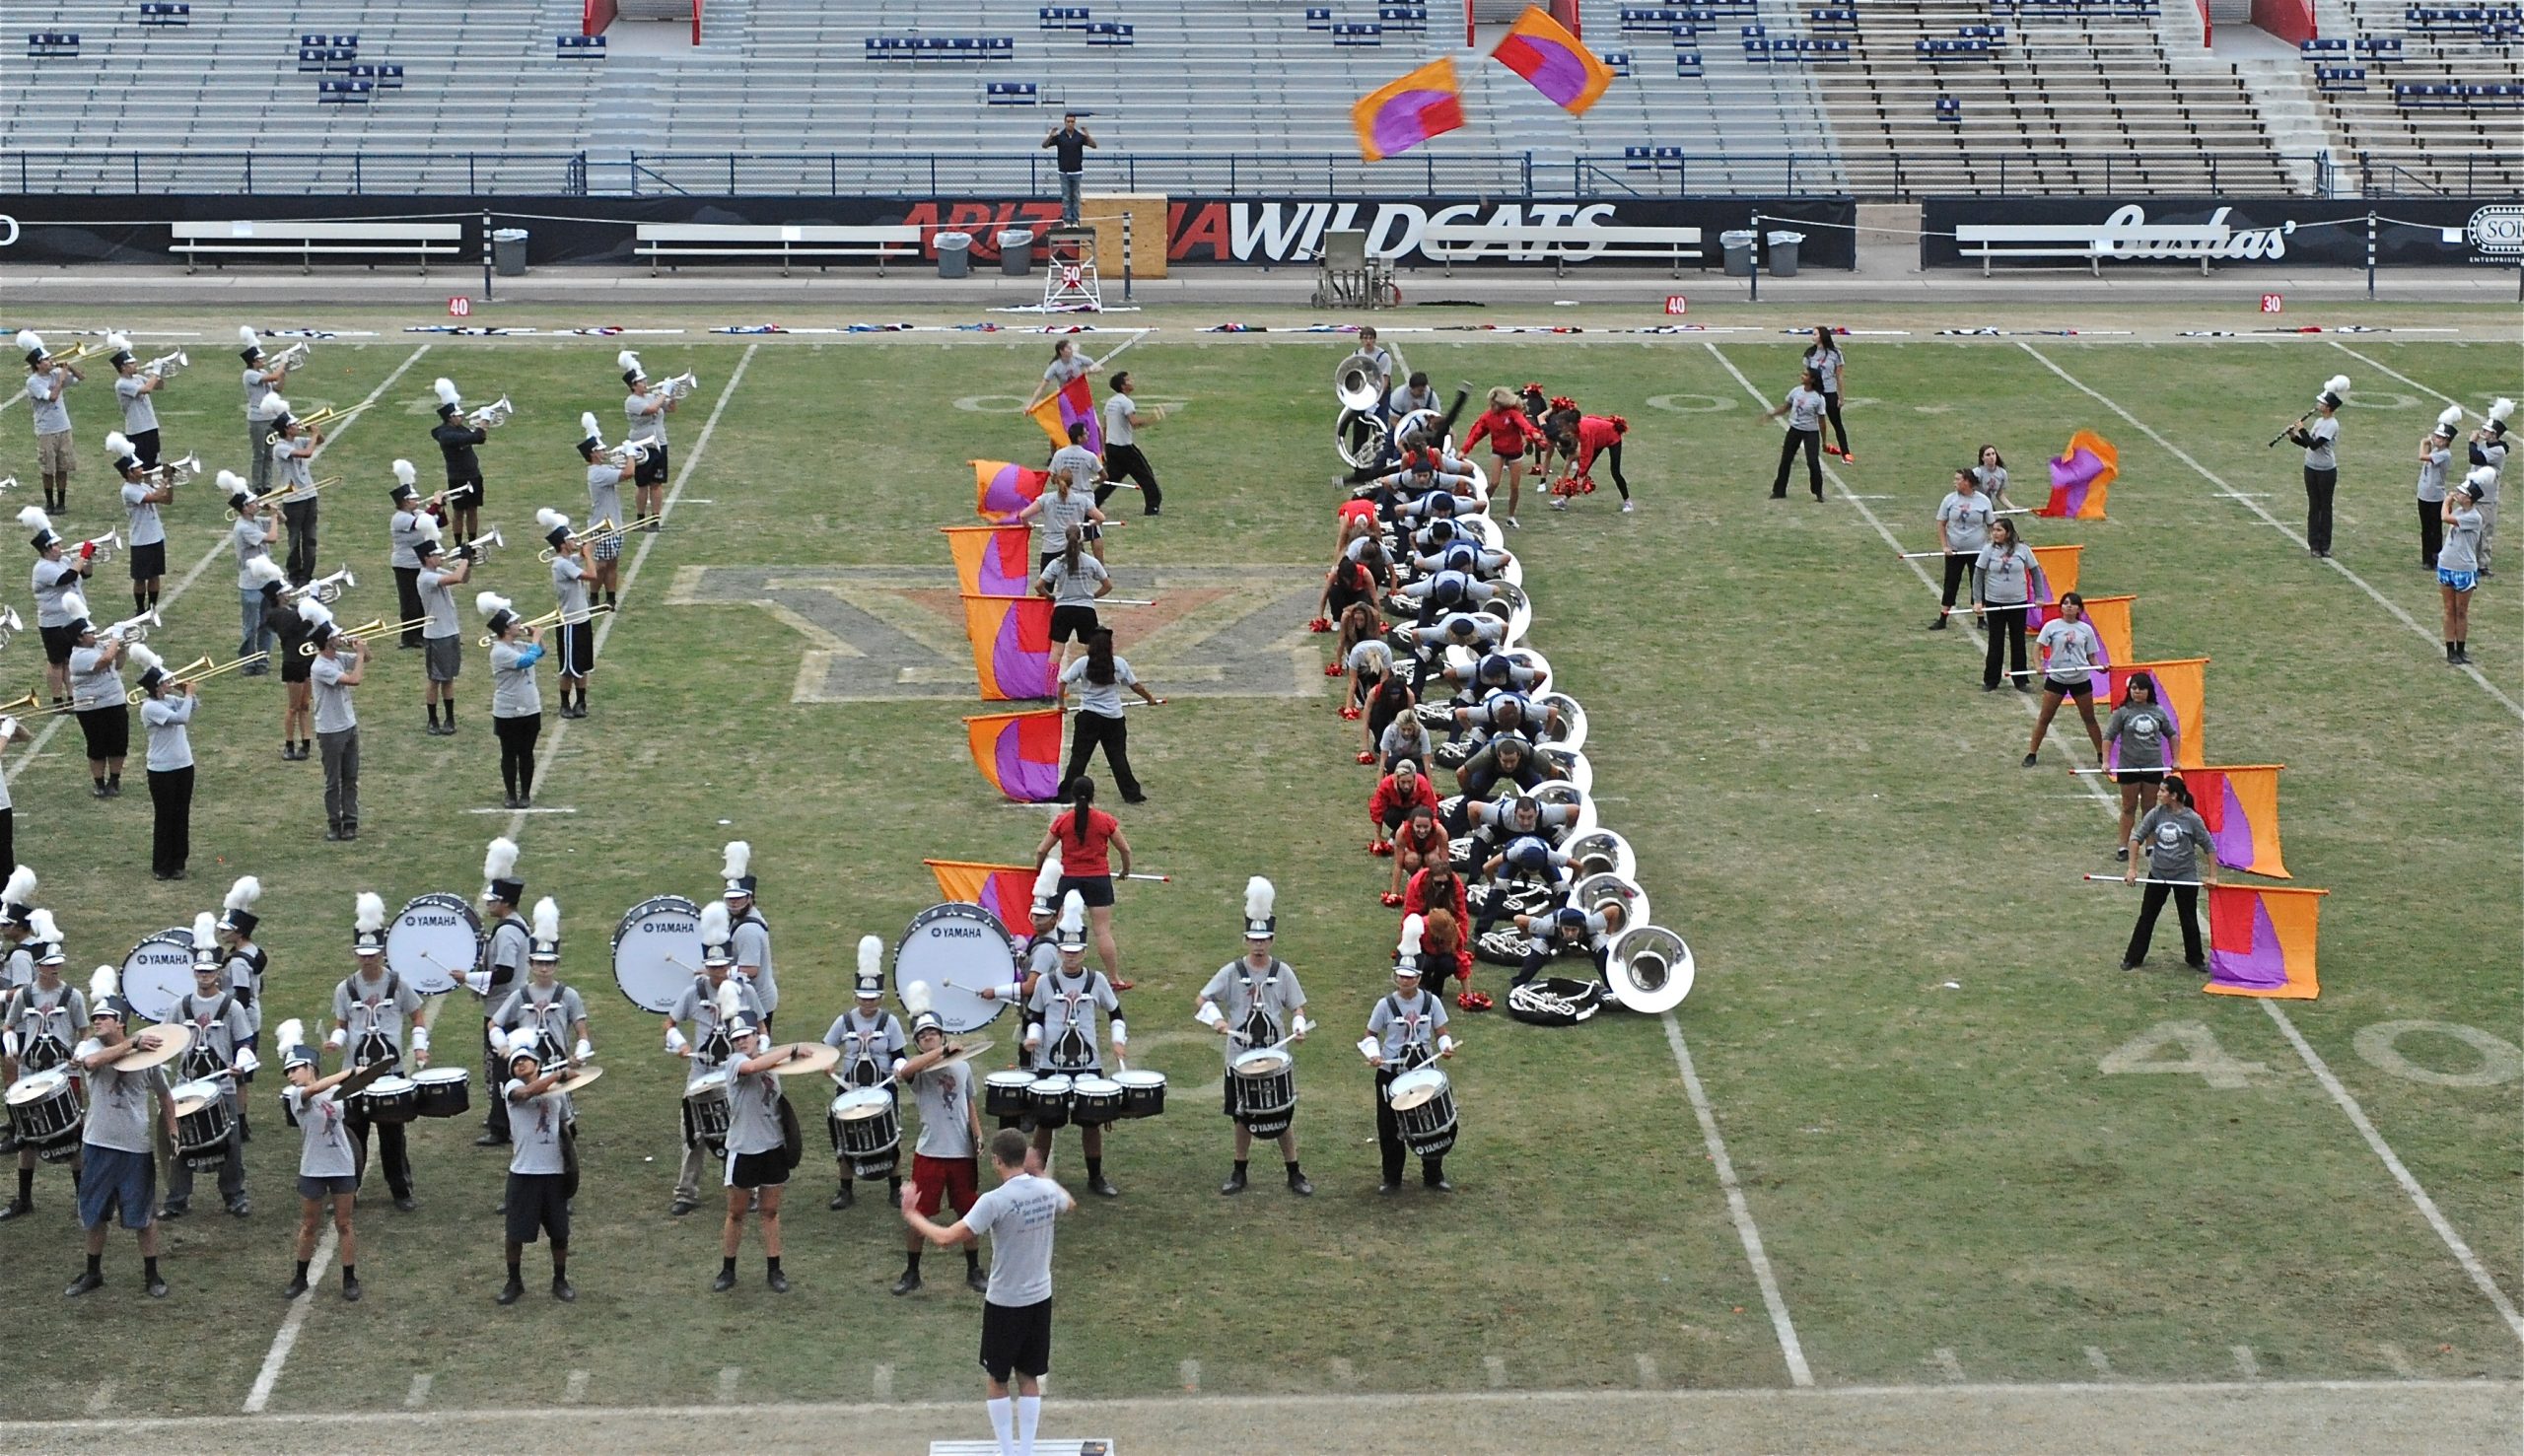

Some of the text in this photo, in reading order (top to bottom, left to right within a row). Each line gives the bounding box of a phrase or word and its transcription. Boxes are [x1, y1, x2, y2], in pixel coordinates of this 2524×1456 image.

[882, 203, 1230, 260] ARIZA
[1063, 266, 1081, 281] 50
[450, 298, 468, 315] 40
[1668, 297, 1686, 313] 40
[2263, 295, 2281, 312] 30
[417, 916, 457, 927] YAMAHA
[656, 923, 695, 933] YAMAHA
[944, 928, 982, 937] YAMAHA
[149, 954, 188, 965] YAMAHA
[1258, 1120, 1288, 1133] YAMAHA
[50, 1141, 80, 1157] YAMAHA
[1424, 1136, 1453, 1153] YAMAHA
[865, 1160, 894, 1174] YAMAHA
